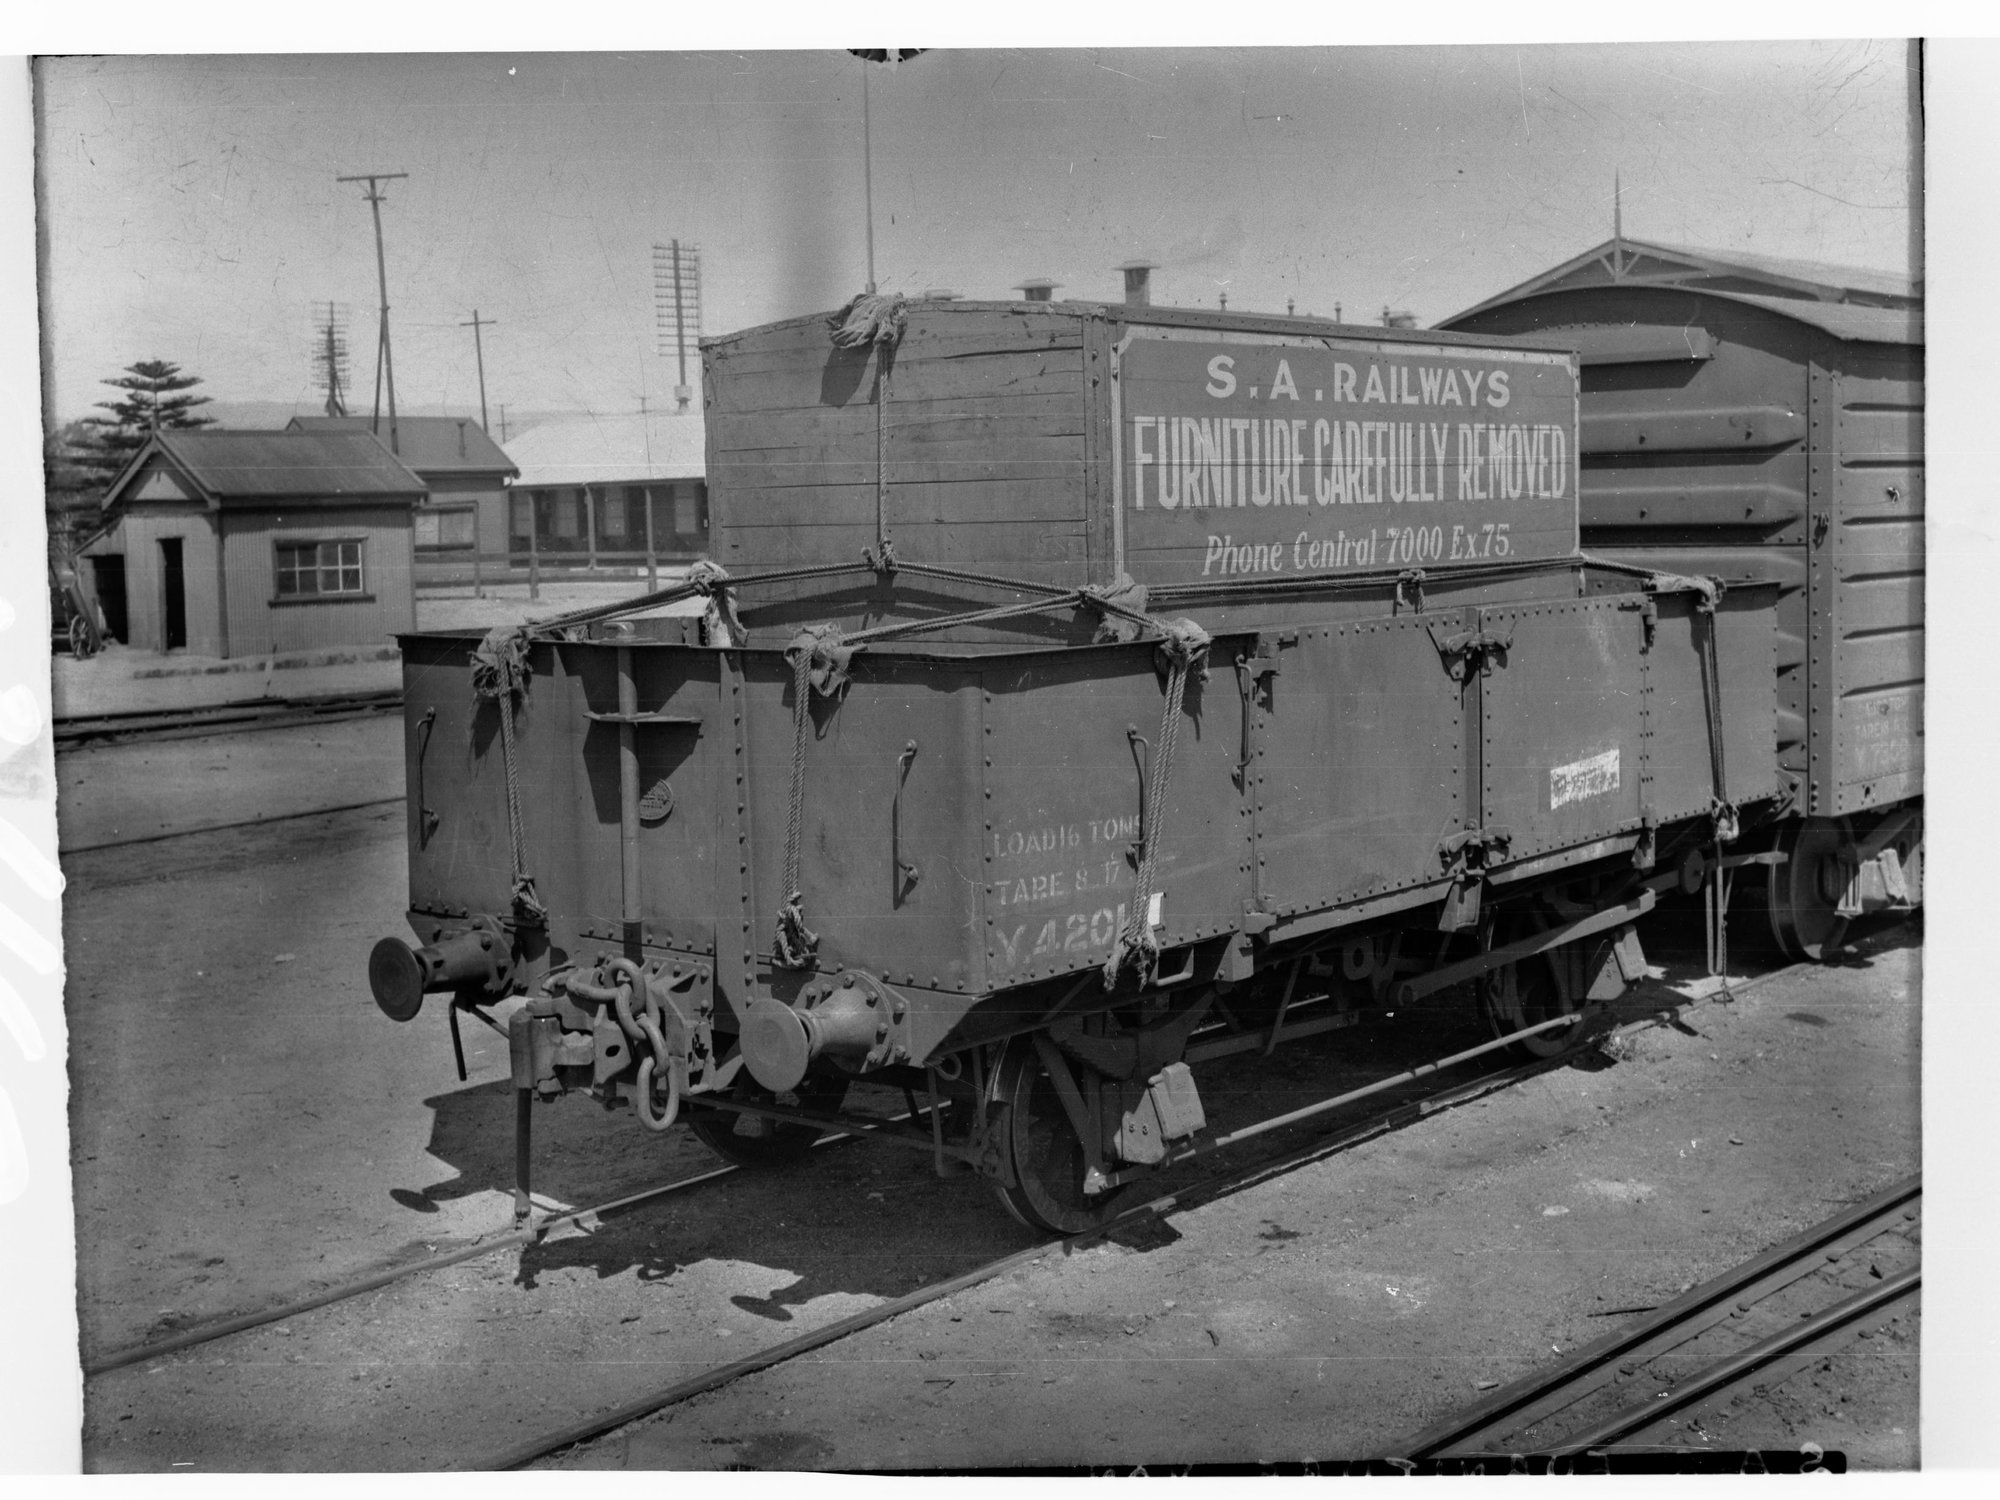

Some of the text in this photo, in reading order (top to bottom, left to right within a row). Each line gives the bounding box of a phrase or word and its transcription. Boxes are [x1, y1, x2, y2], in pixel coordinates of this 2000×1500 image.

[1333, 362, 1511, 408] RAILWAYS
[1133, 416, 1567, 511] FURNITURE CAREFULLY REMOVED
[1201, 534, 1283, 576] Phone
[1294, 529, 1376, 570] Central
[1386, 526, 1443, 563] 7000
[995, 871, 1064, 905] TARE
